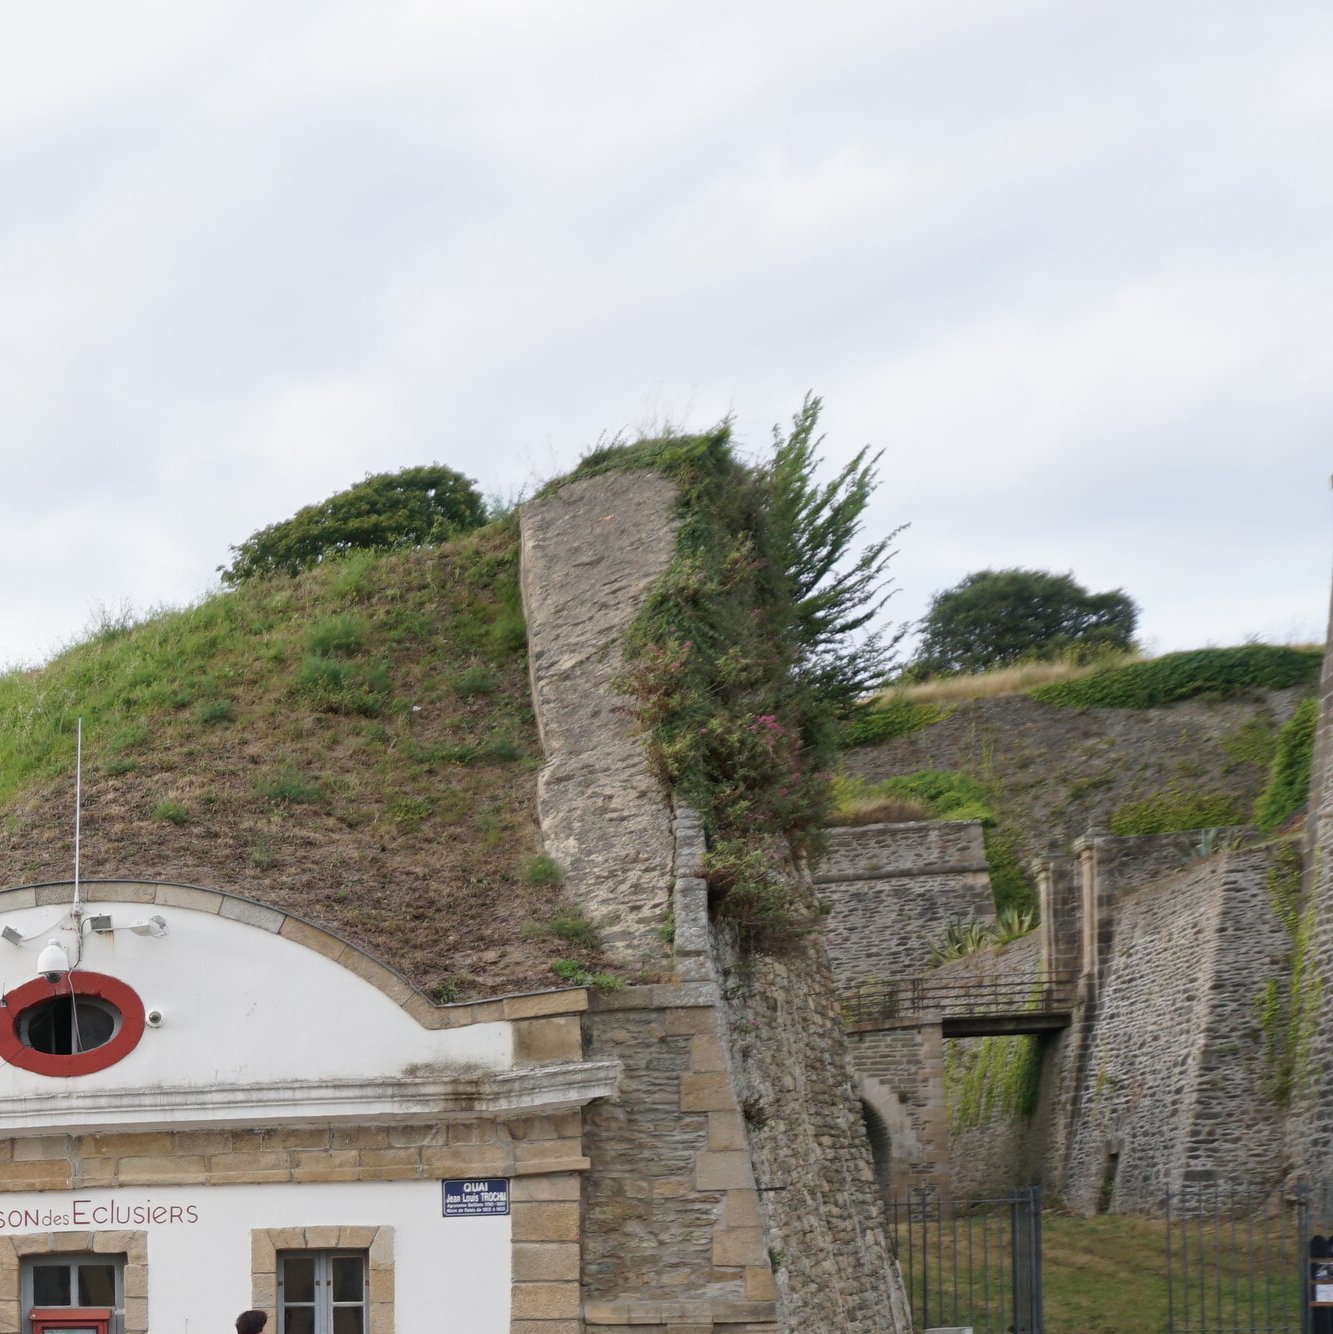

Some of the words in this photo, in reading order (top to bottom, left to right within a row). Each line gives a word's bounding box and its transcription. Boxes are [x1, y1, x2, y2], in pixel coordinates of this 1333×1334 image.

[463, 1182, 488, 1192] QUAI
[446, 1193, 461, 1203] Jean
[462, 1193, 479, 1202] Louis
[480, 1192, 506, 1202] TROCHU
[41, 1209, 70, 1226] des
